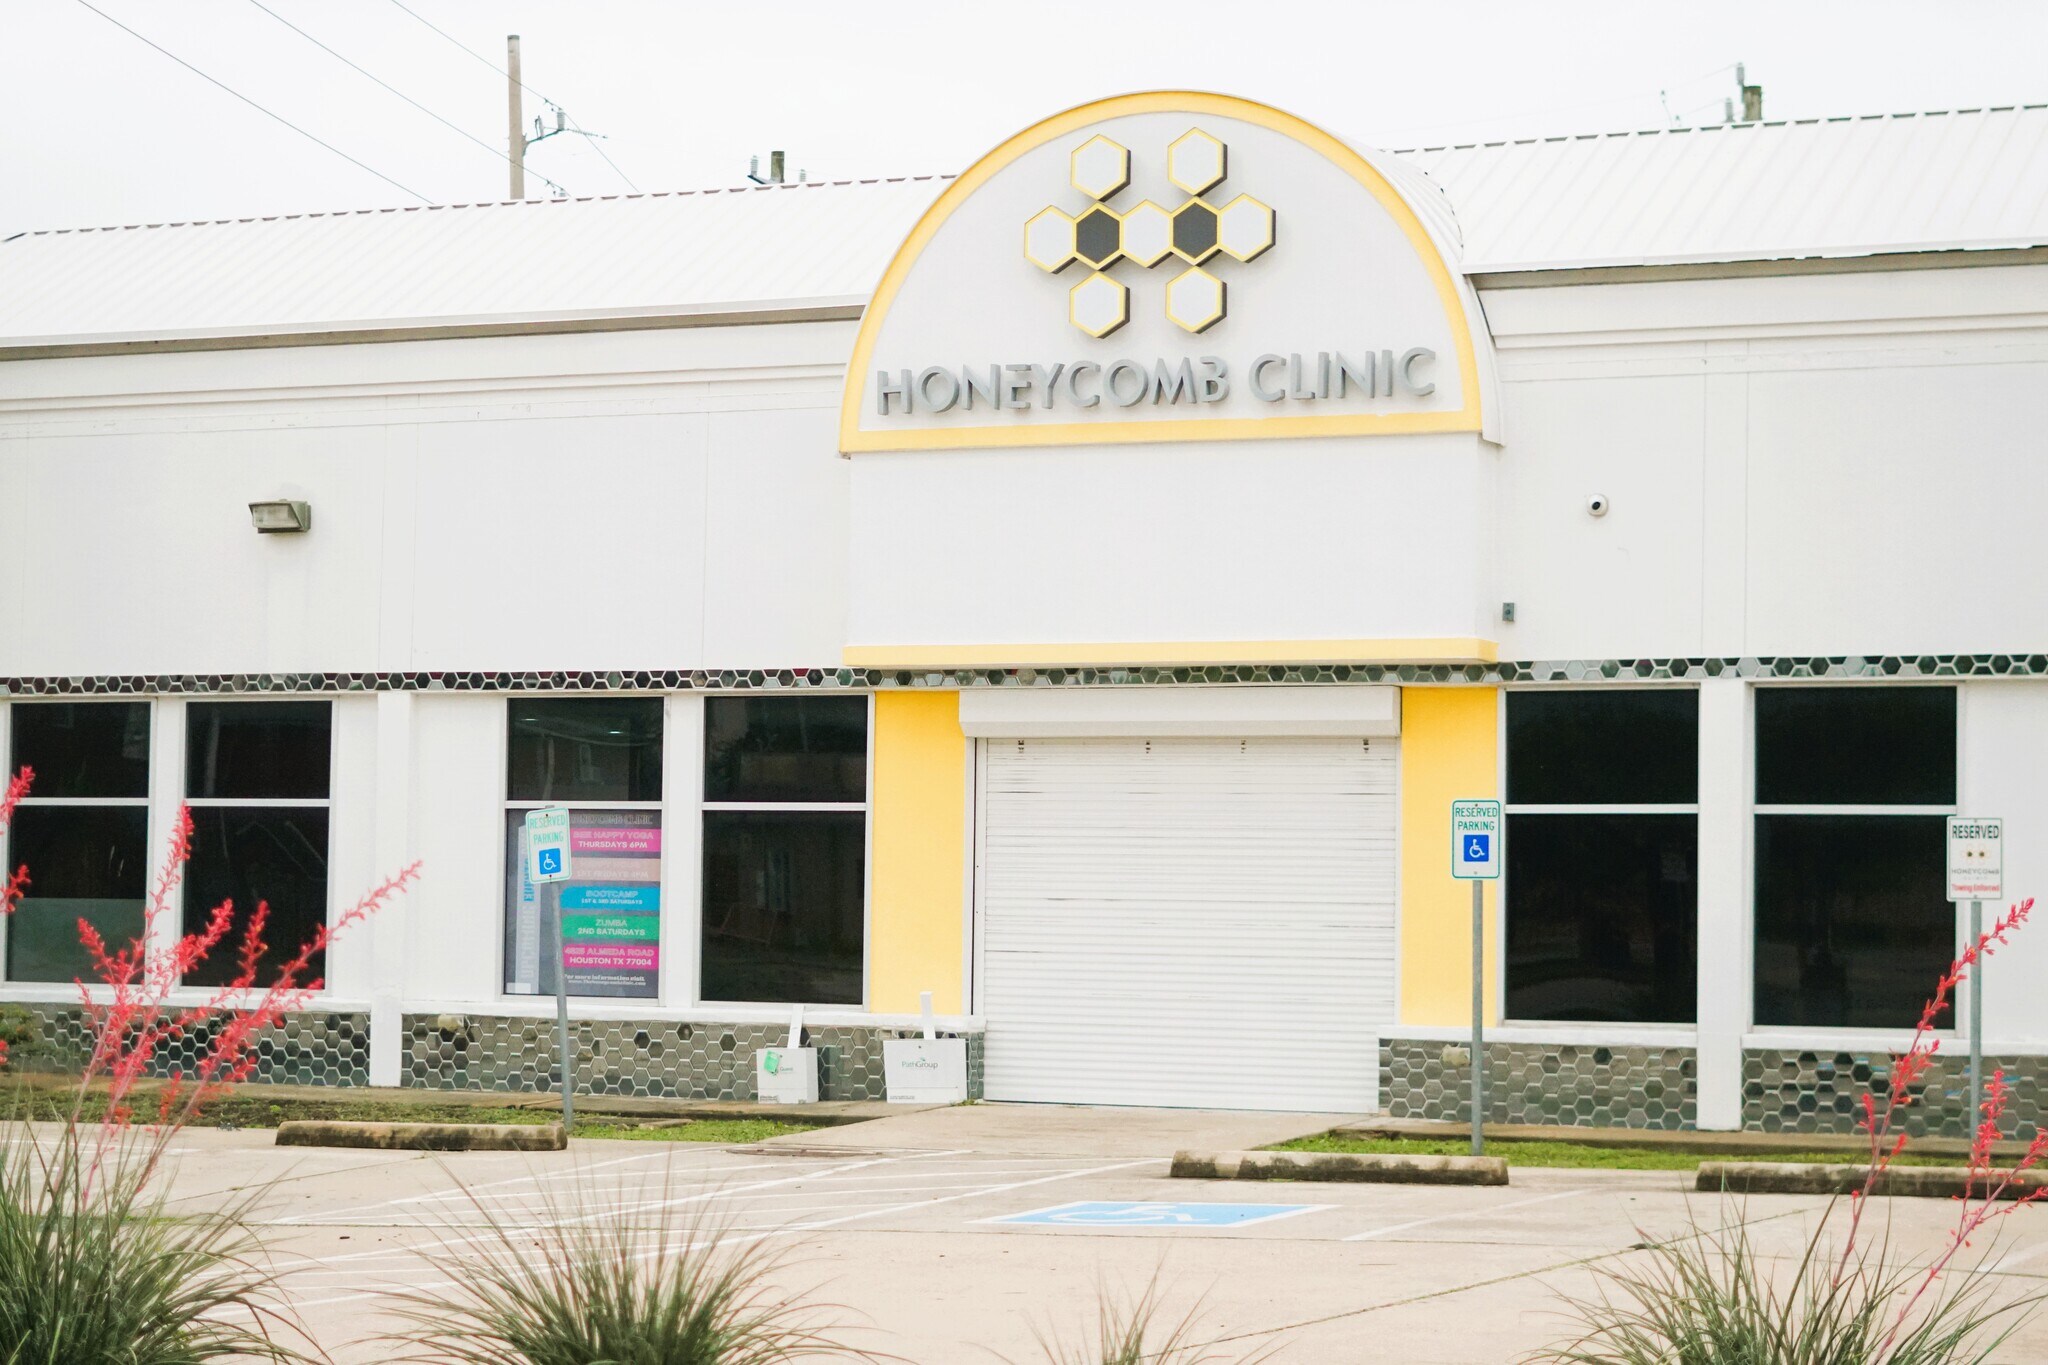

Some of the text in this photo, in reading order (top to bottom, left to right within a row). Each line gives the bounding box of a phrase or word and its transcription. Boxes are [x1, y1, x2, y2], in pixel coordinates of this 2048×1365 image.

[877, 346, 1436, 416] HONEYCOMB CLINIC
[1455, 807, 1498, 818] RESERVED
[530, 814, 566, 829] RESERVED
[1457, 821, 1495, 831] PARKING
[594, 831, 625, 839] HAPPY
[627, 832, 654, 840] YOGA
[1952, 825, 2000, 839] RESERVED
[533, 831, 564, 845] PARKING
[578, 841, 628, 849] THURSDAYS
[1951, 867, 2000, 875] HONEYCOMB
[585, 890, 639, 899] BOOTCAMP
[595, 918, 628, 927] ZUMBA
[596, 928, 645, 936] SATURDAYS
[587, 948, 626, 957] ALMEDA
[627, 949, 655, 957] ROAD
[569, 957, 611, 965] HOUSTON
[626, 958, 652, 966] 77004
[901, 1060, 939, 1070] PathGroup
